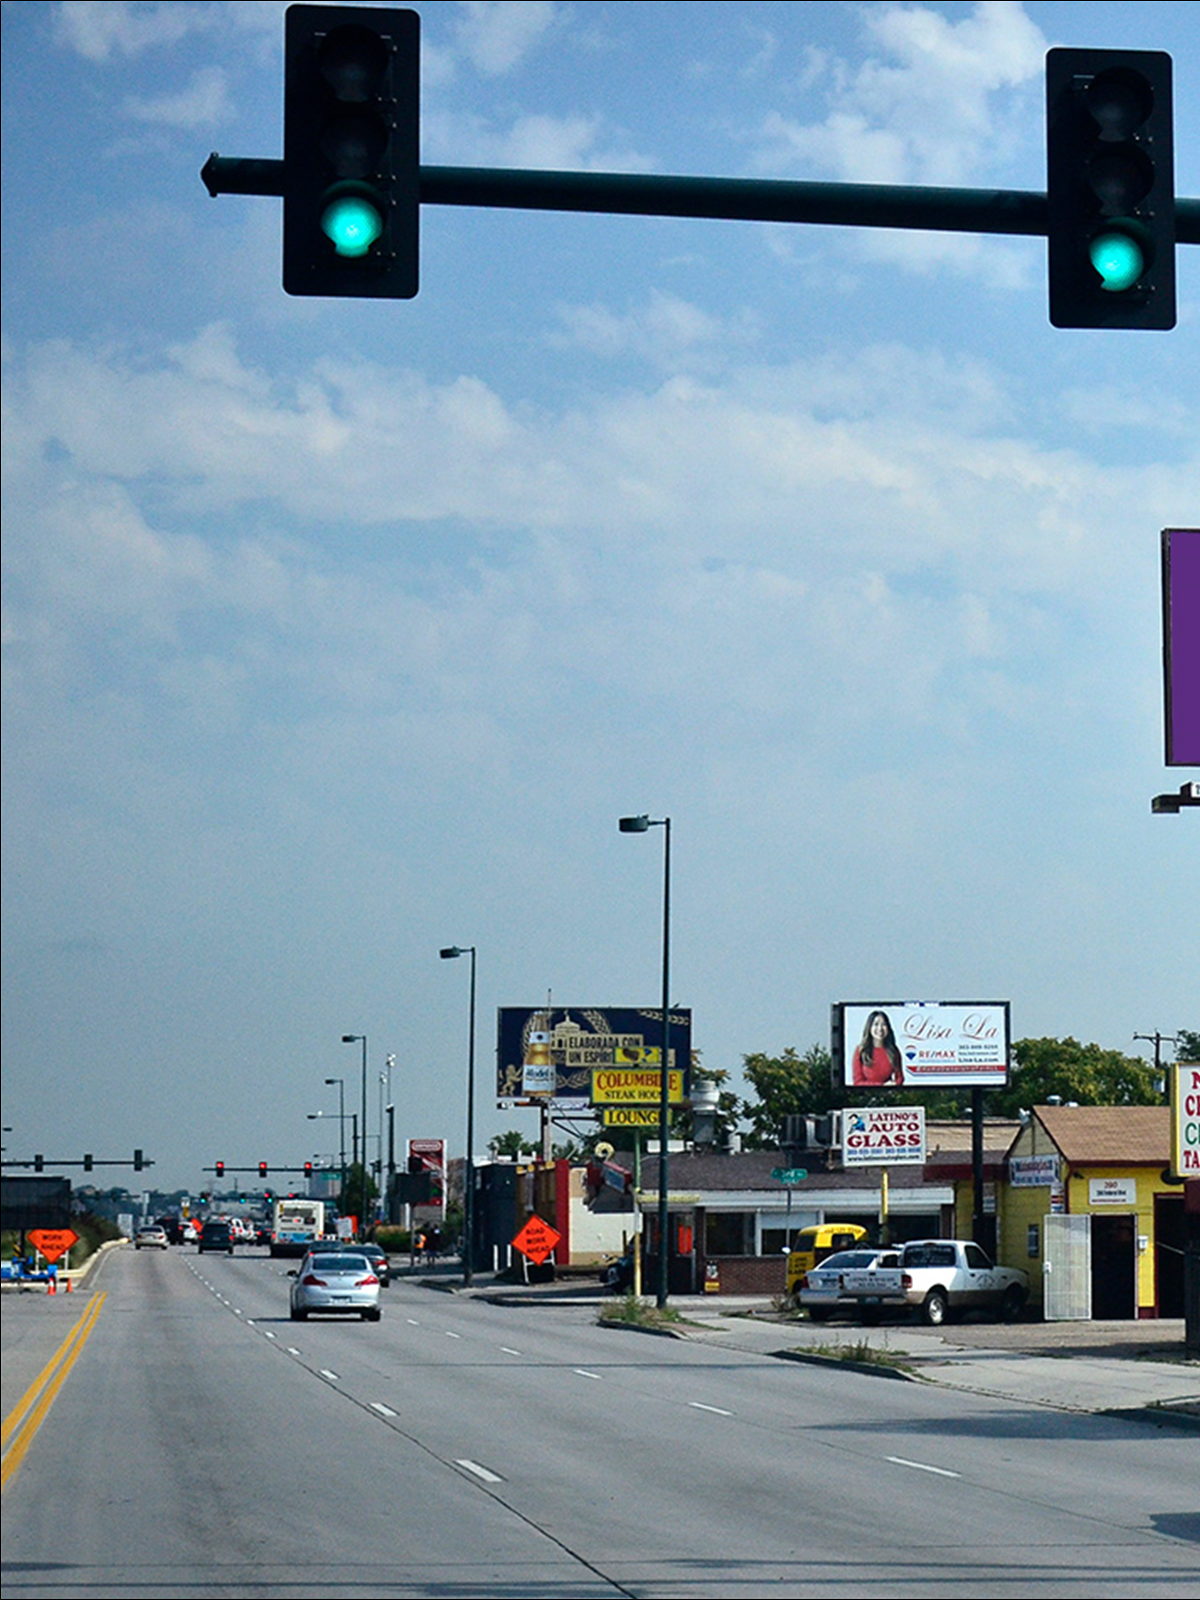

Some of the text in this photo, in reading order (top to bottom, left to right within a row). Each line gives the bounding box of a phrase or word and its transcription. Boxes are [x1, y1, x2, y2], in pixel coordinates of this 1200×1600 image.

[902, 1013, 998, 1041] Lisa La
[918, 1051, 955, 1059] RE/MAX
[597, 1071, 678, 1091] COLUMBIE
[605, 1090, 636, 1100] STEAK
[608, 1110, 662, 1124] LOUNG
[869, 1112, 919, 1122] LATINO'S
[868, 1122, 920, 1133] AUTO
[847, 1133, 921, 1148] GLASS
[526, 1227, 546, 1235] ROAD
[526, 1237, 546, 1245] WORK
[41, 1243, 66, 1251] AHEAD
[526, 1245, 550, 1254] AHEAD
